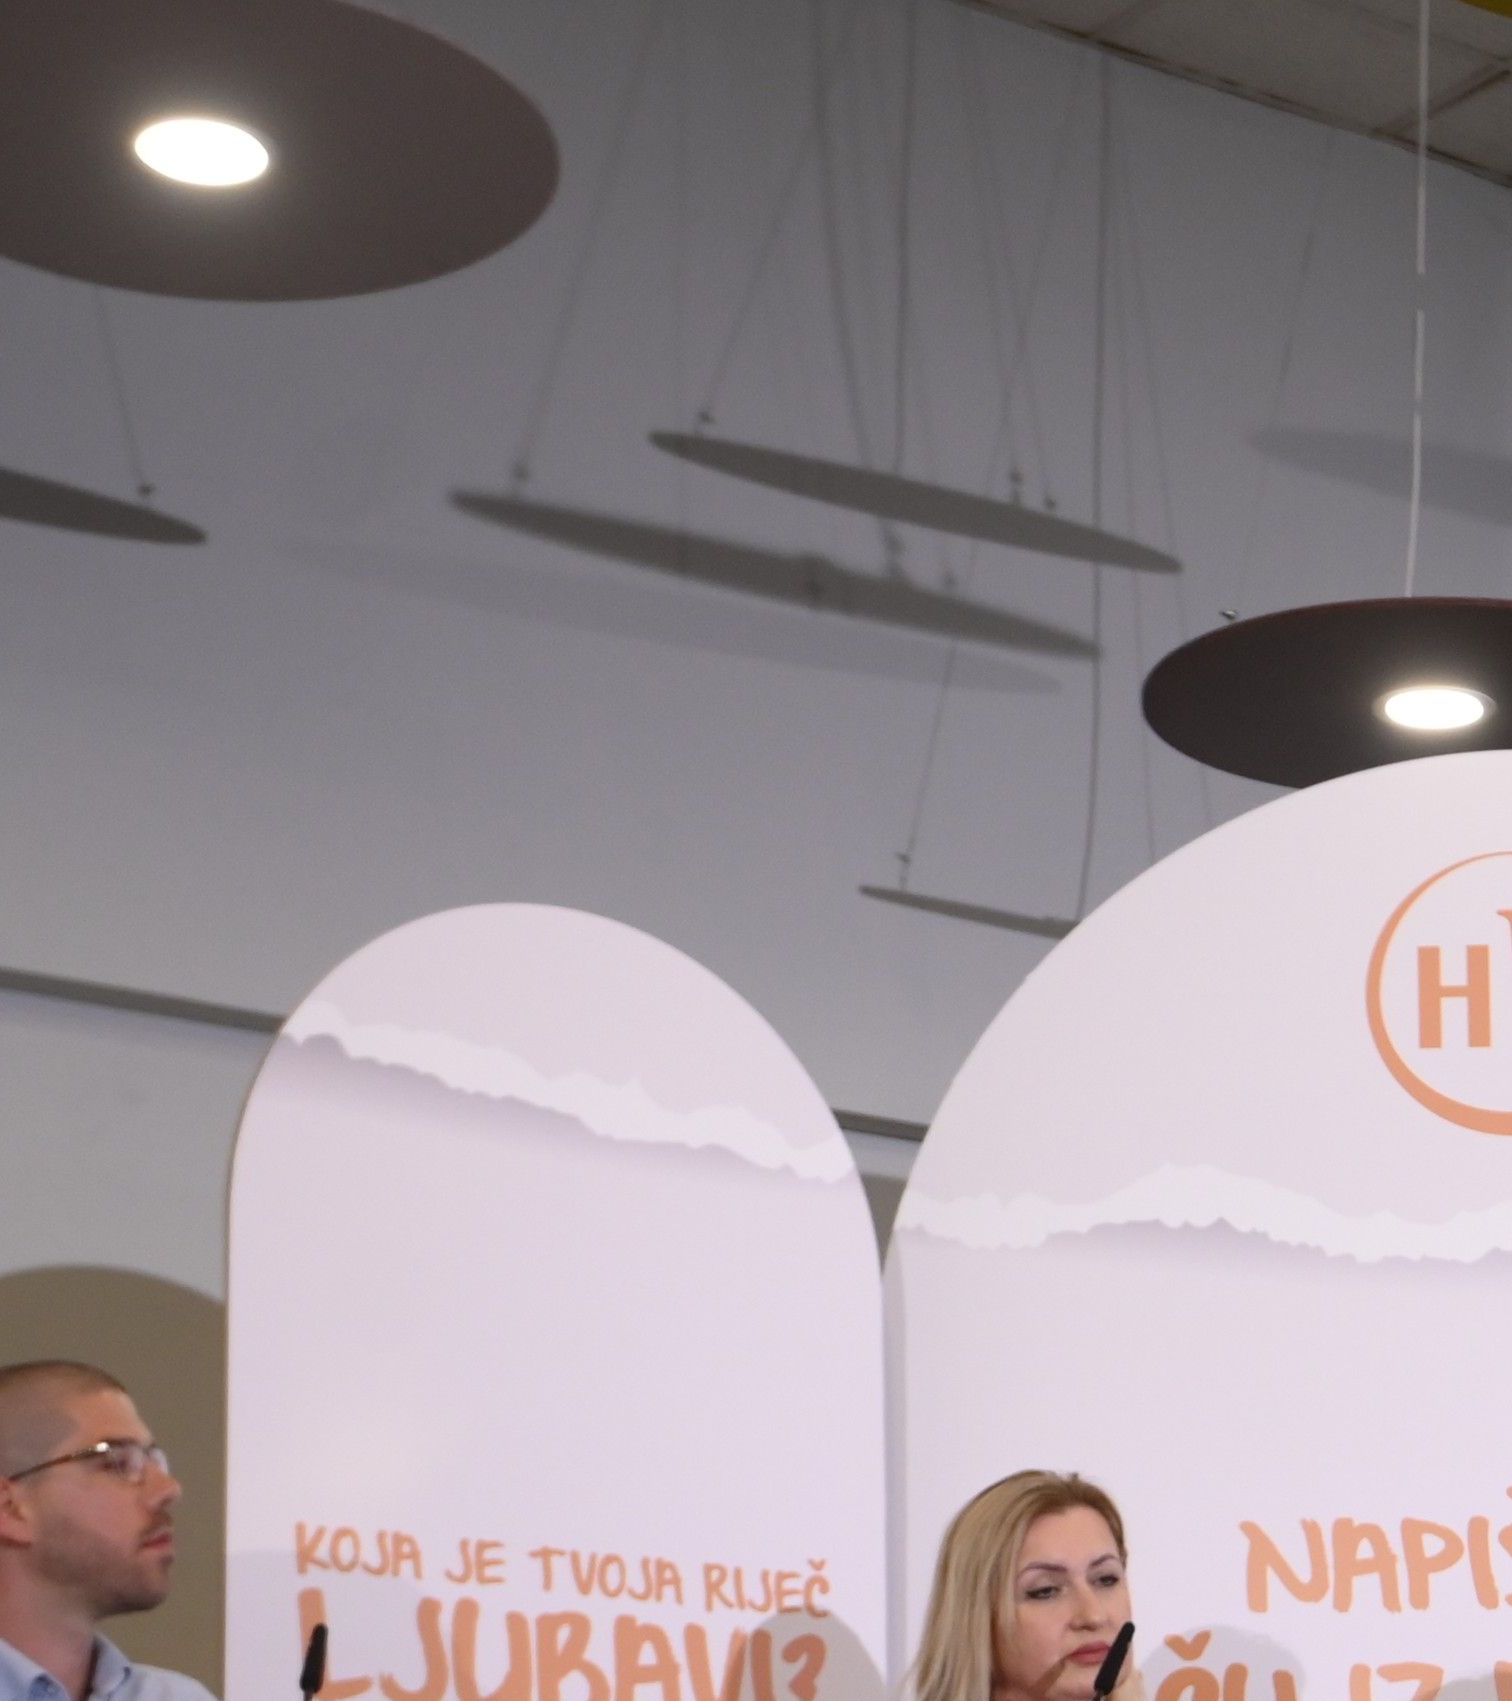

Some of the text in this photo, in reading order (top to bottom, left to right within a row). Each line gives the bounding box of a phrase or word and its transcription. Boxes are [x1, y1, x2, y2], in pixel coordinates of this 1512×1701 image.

[295, 1522, 832, 1619] KOJA JE TVOJA RIJEČ
